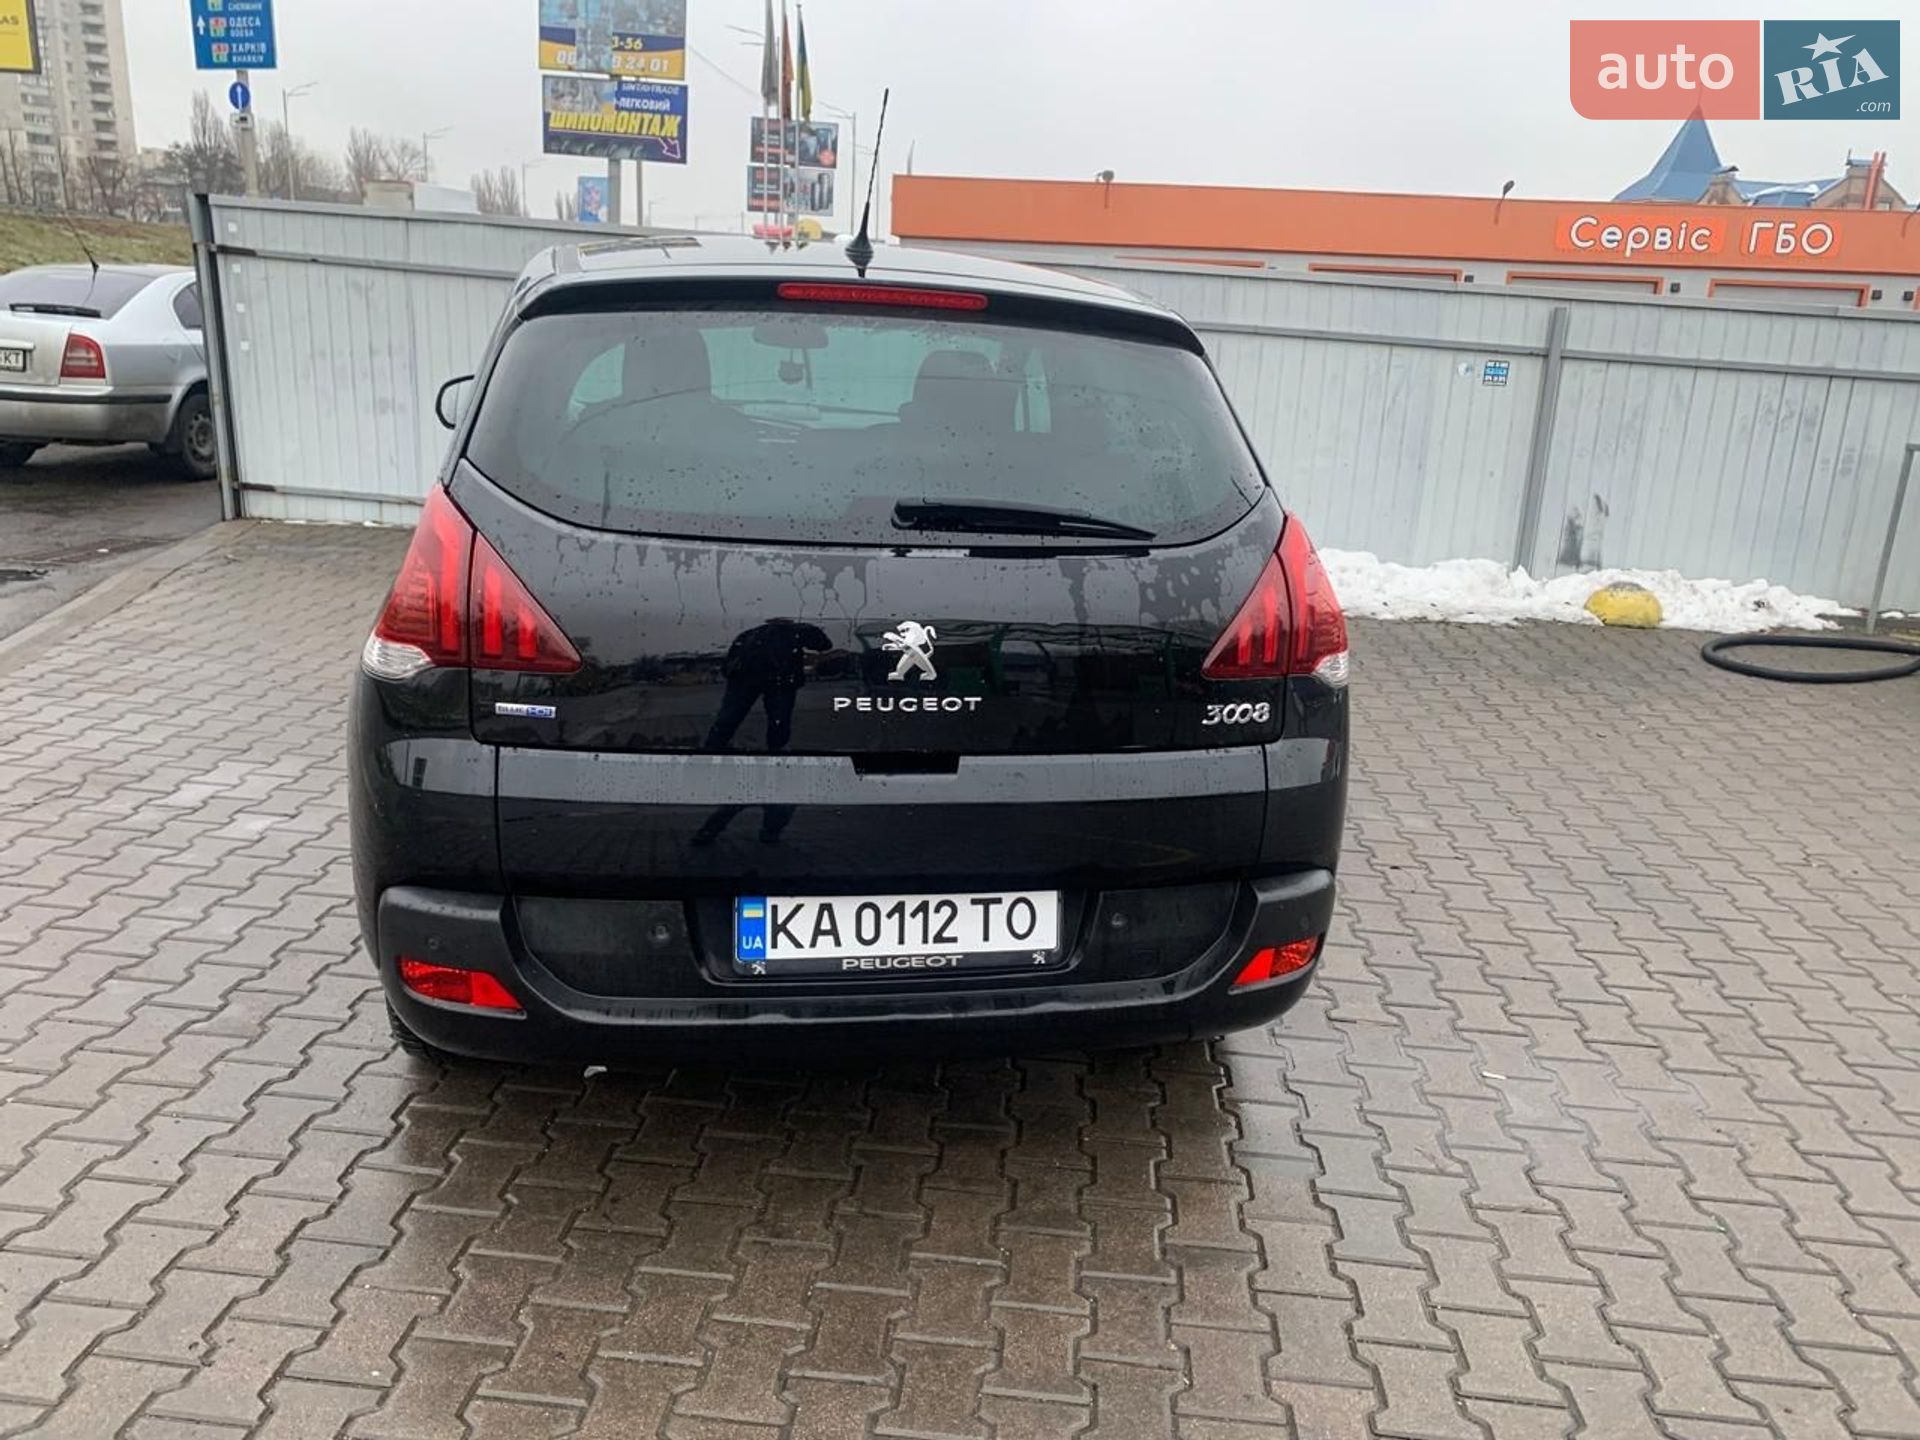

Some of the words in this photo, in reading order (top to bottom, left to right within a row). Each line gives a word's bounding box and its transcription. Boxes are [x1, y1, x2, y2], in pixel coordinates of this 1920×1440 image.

[229, 16, 262, 27] ОДЕСА
[231, 42, 267, 53] ХАРКІВ
[549, 110, 682, 138] ШИНОМОНТАЖ
[1569, 215, 1712, 258] Сервіс
[1748, 221, 1834, 256] ГБО
[833, 696, 982, 712] PEUGEOT
[1201, 702, 1271, 725] 3008
[742, 936, 764, 950] UA
[770, 902, 842, 950] KA
[855, 898, 959, 947] 0112
[970, 895, 1037, 943] TO
[841, 954, 964, 970] PEUGEOT
